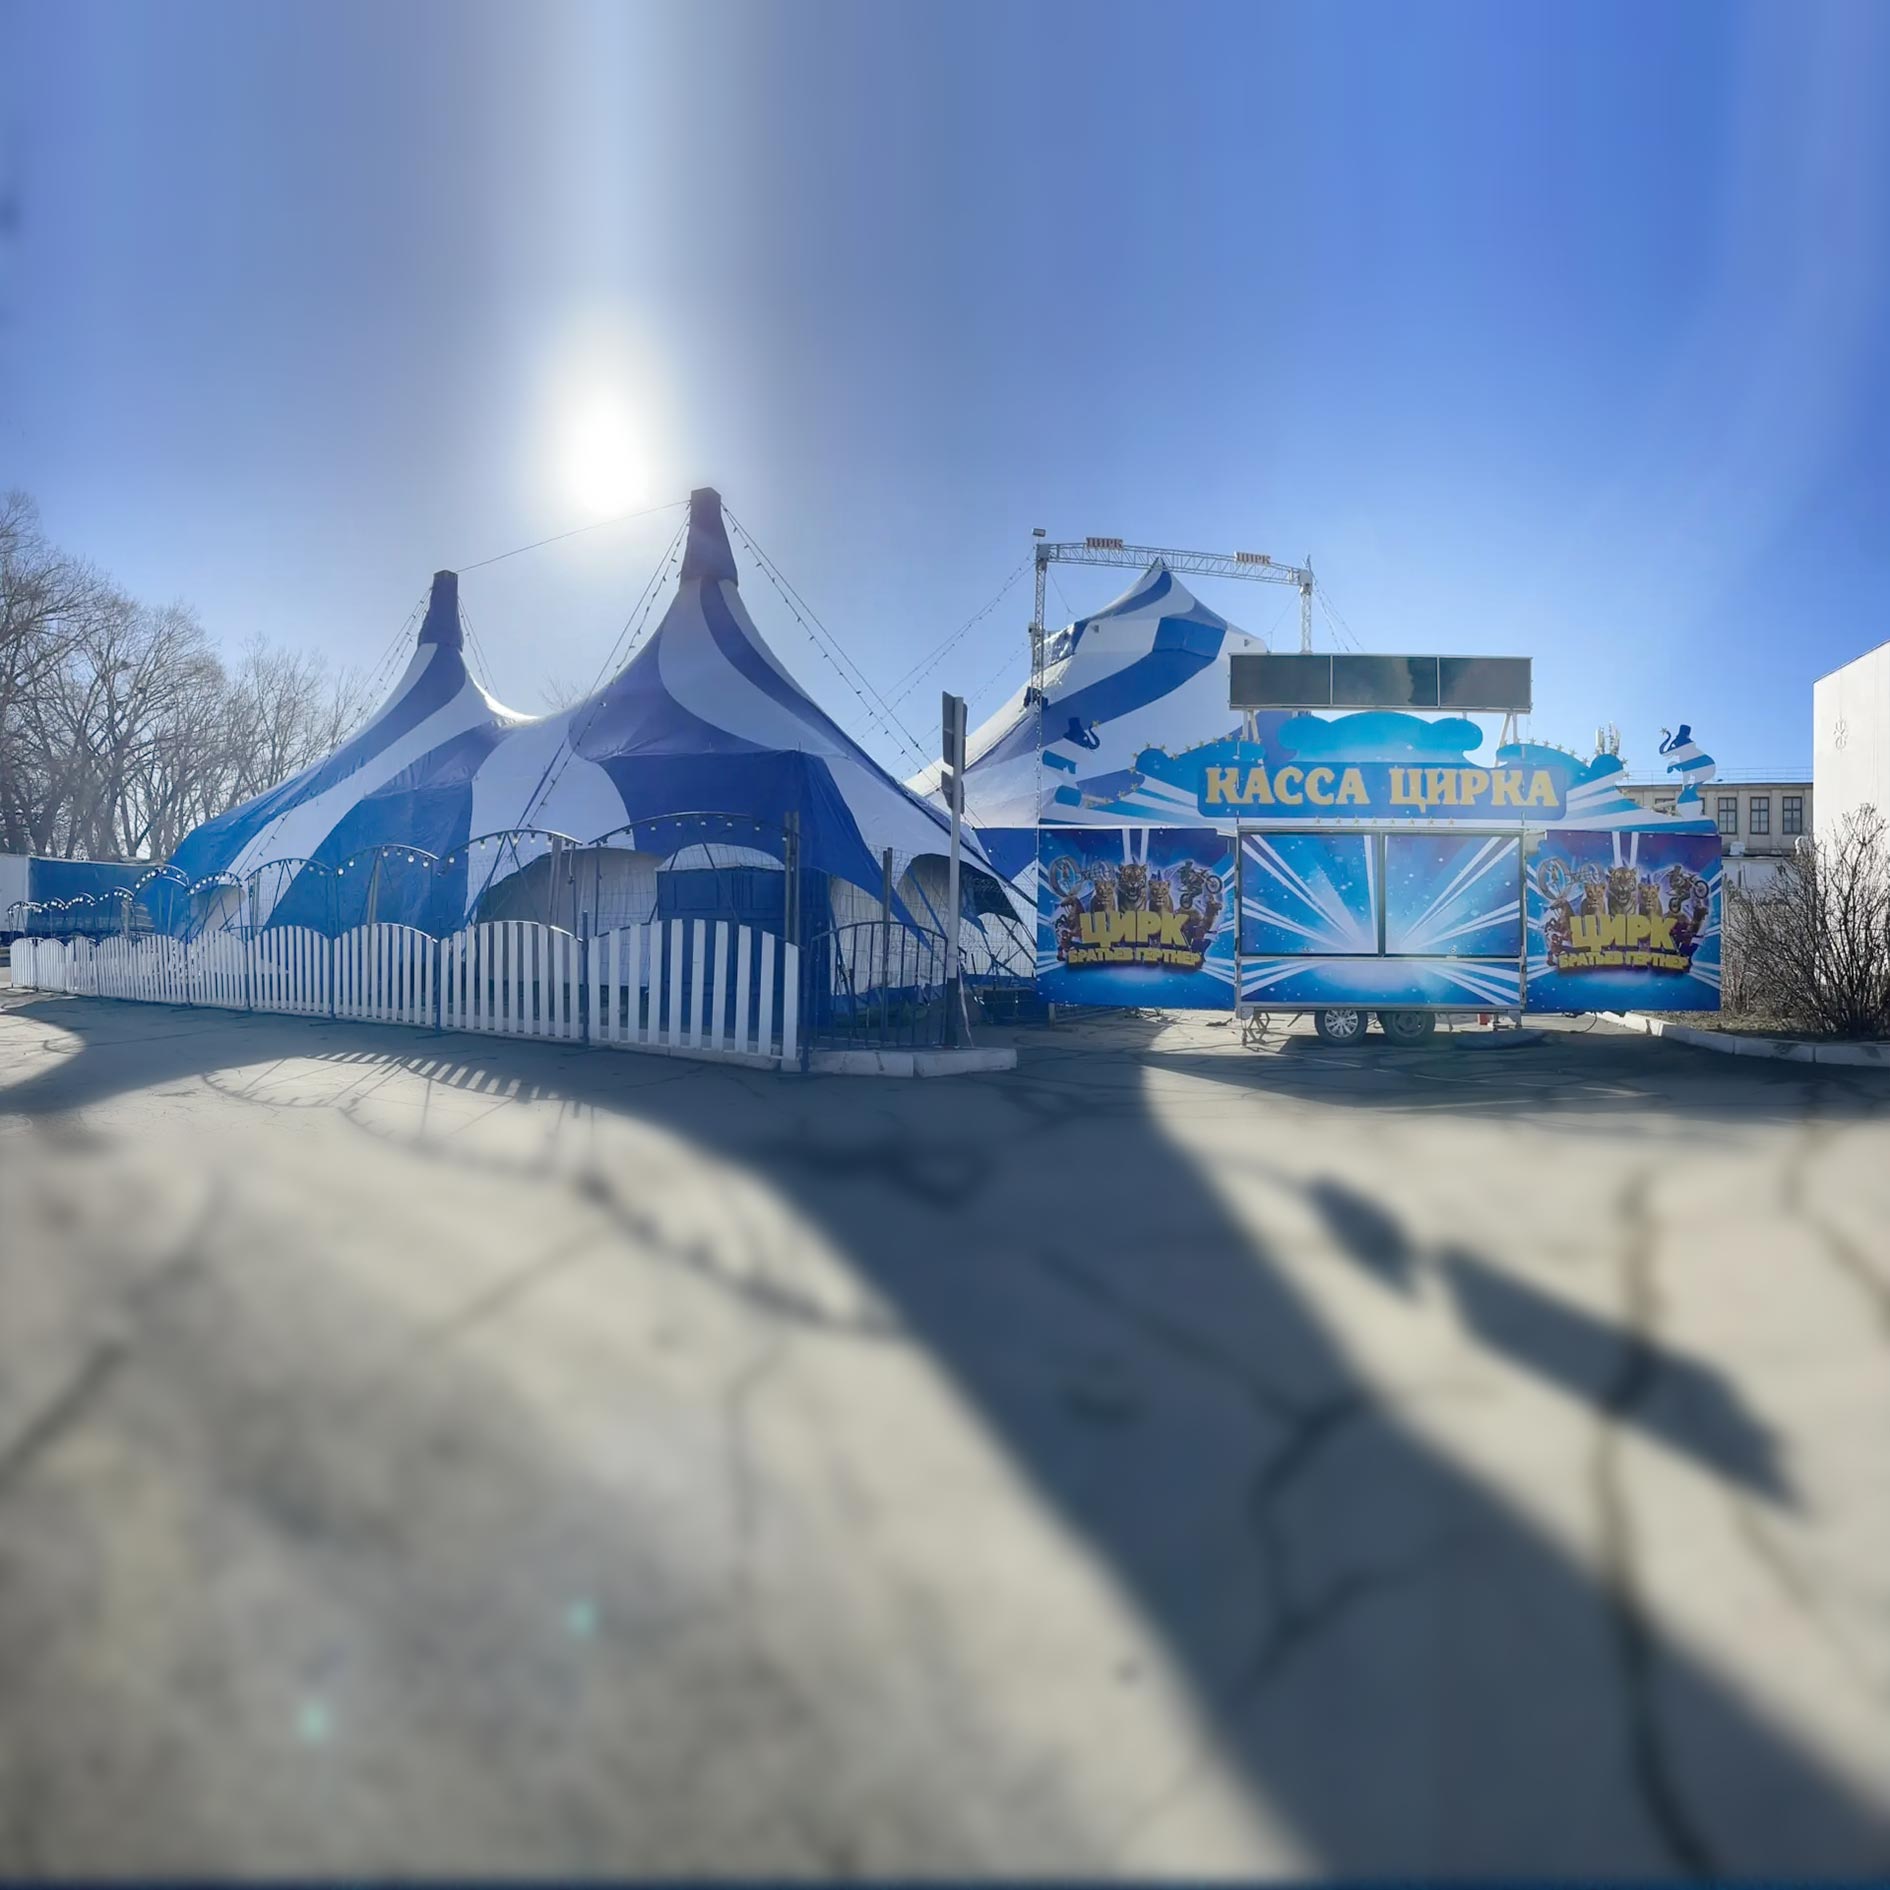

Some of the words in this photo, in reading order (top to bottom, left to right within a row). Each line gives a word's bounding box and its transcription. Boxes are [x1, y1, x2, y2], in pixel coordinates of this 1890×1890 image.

[1206, 767, 1370, 805] КАССА
[1389, 767, 1559, 813] ЦИРКА
[1079, 910, 1189, 948] ЦИРК
[1569, 913, 1678, 951] ЦИРК
